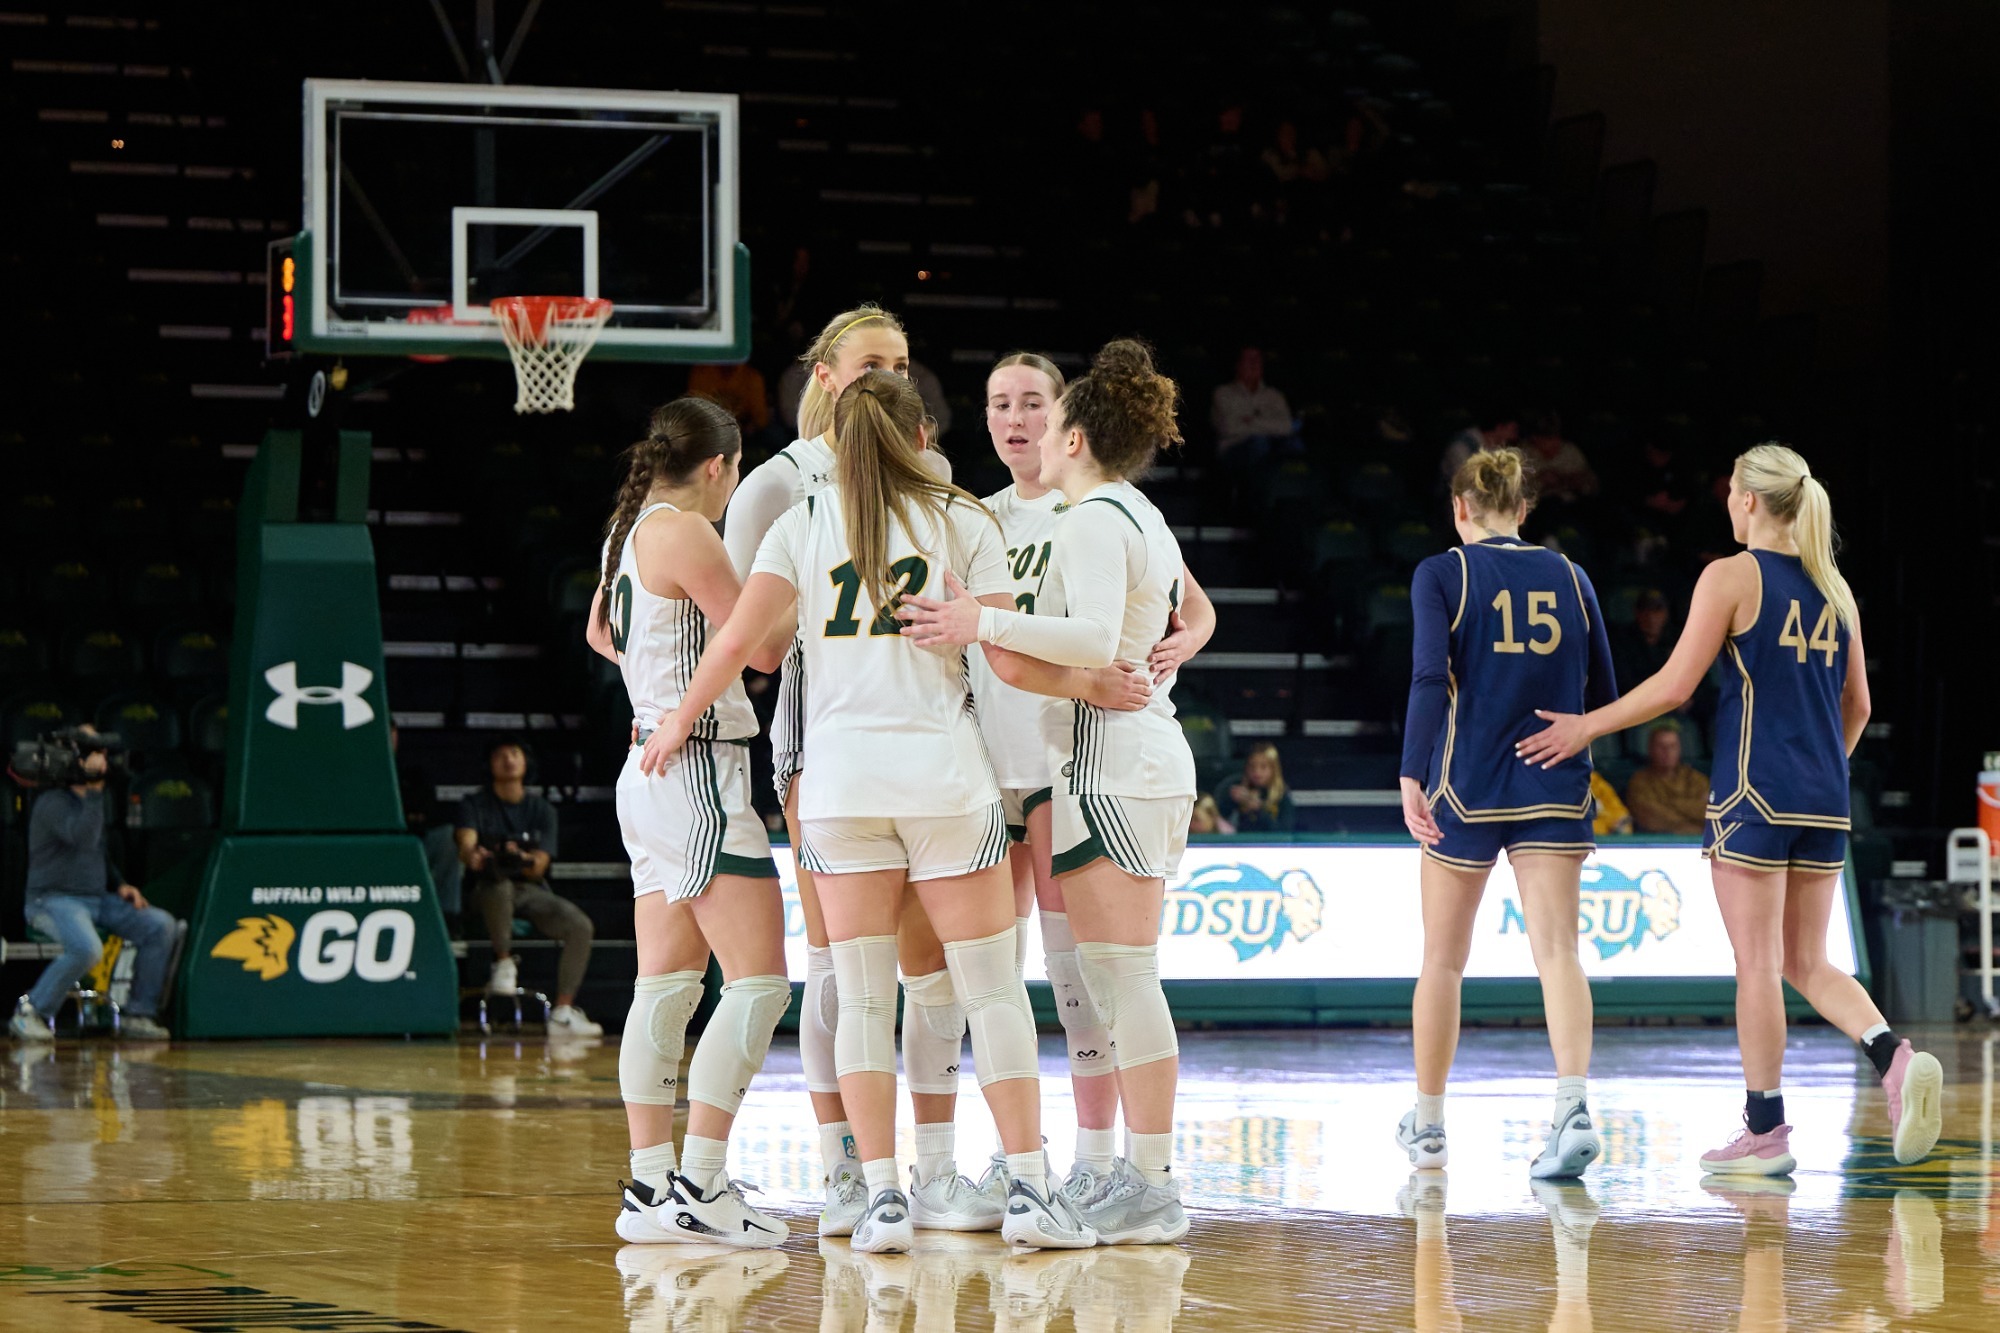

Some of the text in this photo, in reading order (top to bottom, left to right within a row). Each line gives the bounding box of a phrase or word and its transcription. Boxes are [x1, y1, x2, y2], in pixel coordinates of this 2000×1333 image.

[822, 554, 930, 639] 12
[1492, 589, 1562, 656] 15
[1778, 599, 1840, 668] 44
[252, 885, 422, 904] BUFFALO WILD WINGS
[1499, 895, 1637, 938] NSU
[297, 909, 416, 983] GO
